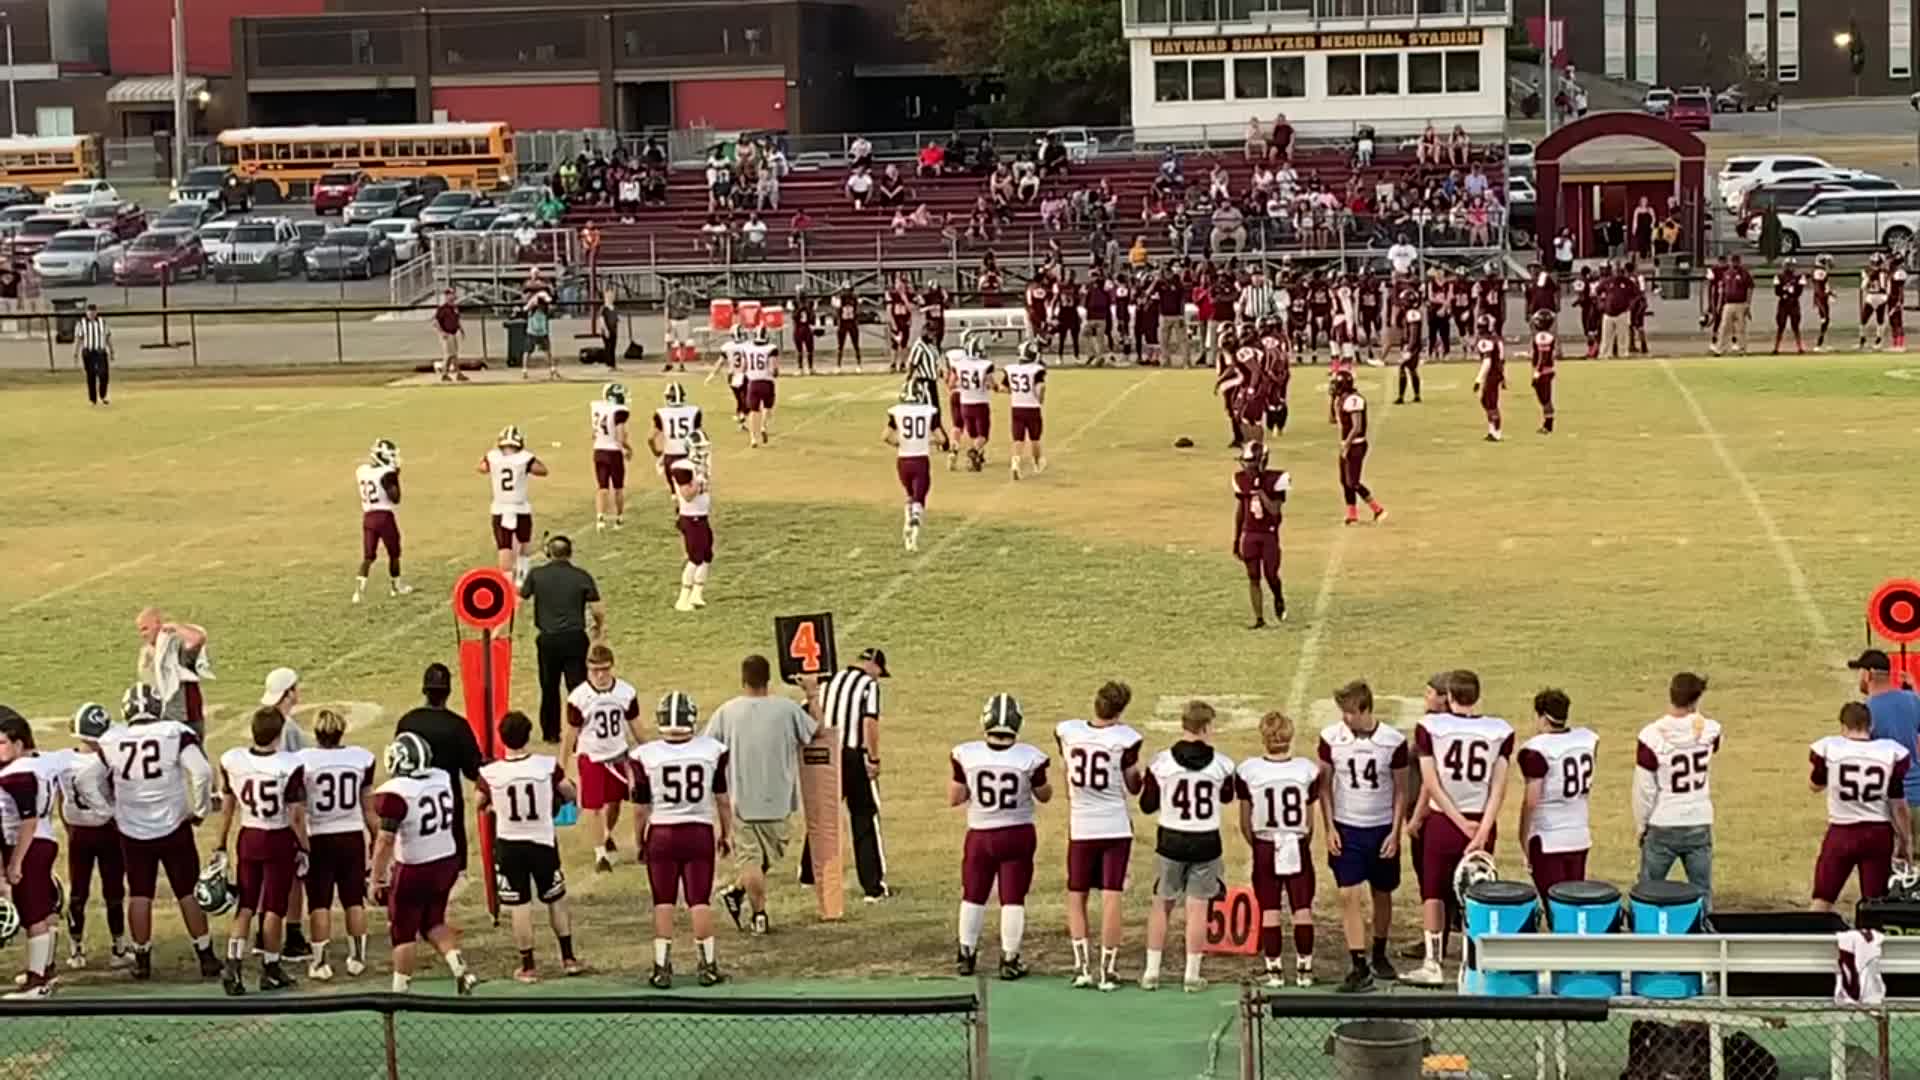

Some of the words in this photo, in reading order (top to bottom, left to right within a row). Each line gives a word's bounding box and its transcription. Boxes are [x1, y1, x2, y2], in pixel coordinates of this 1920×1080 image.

[1153, 39, 1228, 54] HAYWARD
[1320, 33, 1404, 48] MEMORIAL
[1407, 31, 1480, 46] STADIUM
[750, 352, 765, 371] 16
[960, 370, 980, 389] 64
[1010, 372, 1031, 393] 53
[669, 417, 689, 439] 15
[902, 416, 927, 439] 90
[501, 468, 514, 491] 2
[790, 621, 820, 671] 4
[594, 709, 621, 739] 38
[119, 739, 163, 780] 72
[1070, 747, 1111, 790] 36
[1347, 758, 1379, 790] 14
[1444, 739, 1489, 782] 46
[1562, 753, 1593, 798] 82
[1671, 751, 1709, 794] 25
[241, 778, 279, 818] 45
[315, 771, 358, 812] 30
[507, 783, 539, 822] 11
[662, 764, 704, 804] 58
[976, 770, 1019, 810] 62
[1172, 779, 1214, 820] 48
[1839, 763, 1886, 802] 52
[1264, 786, 1302, 828] 18
[1206, 892, 1252, 945] 50
